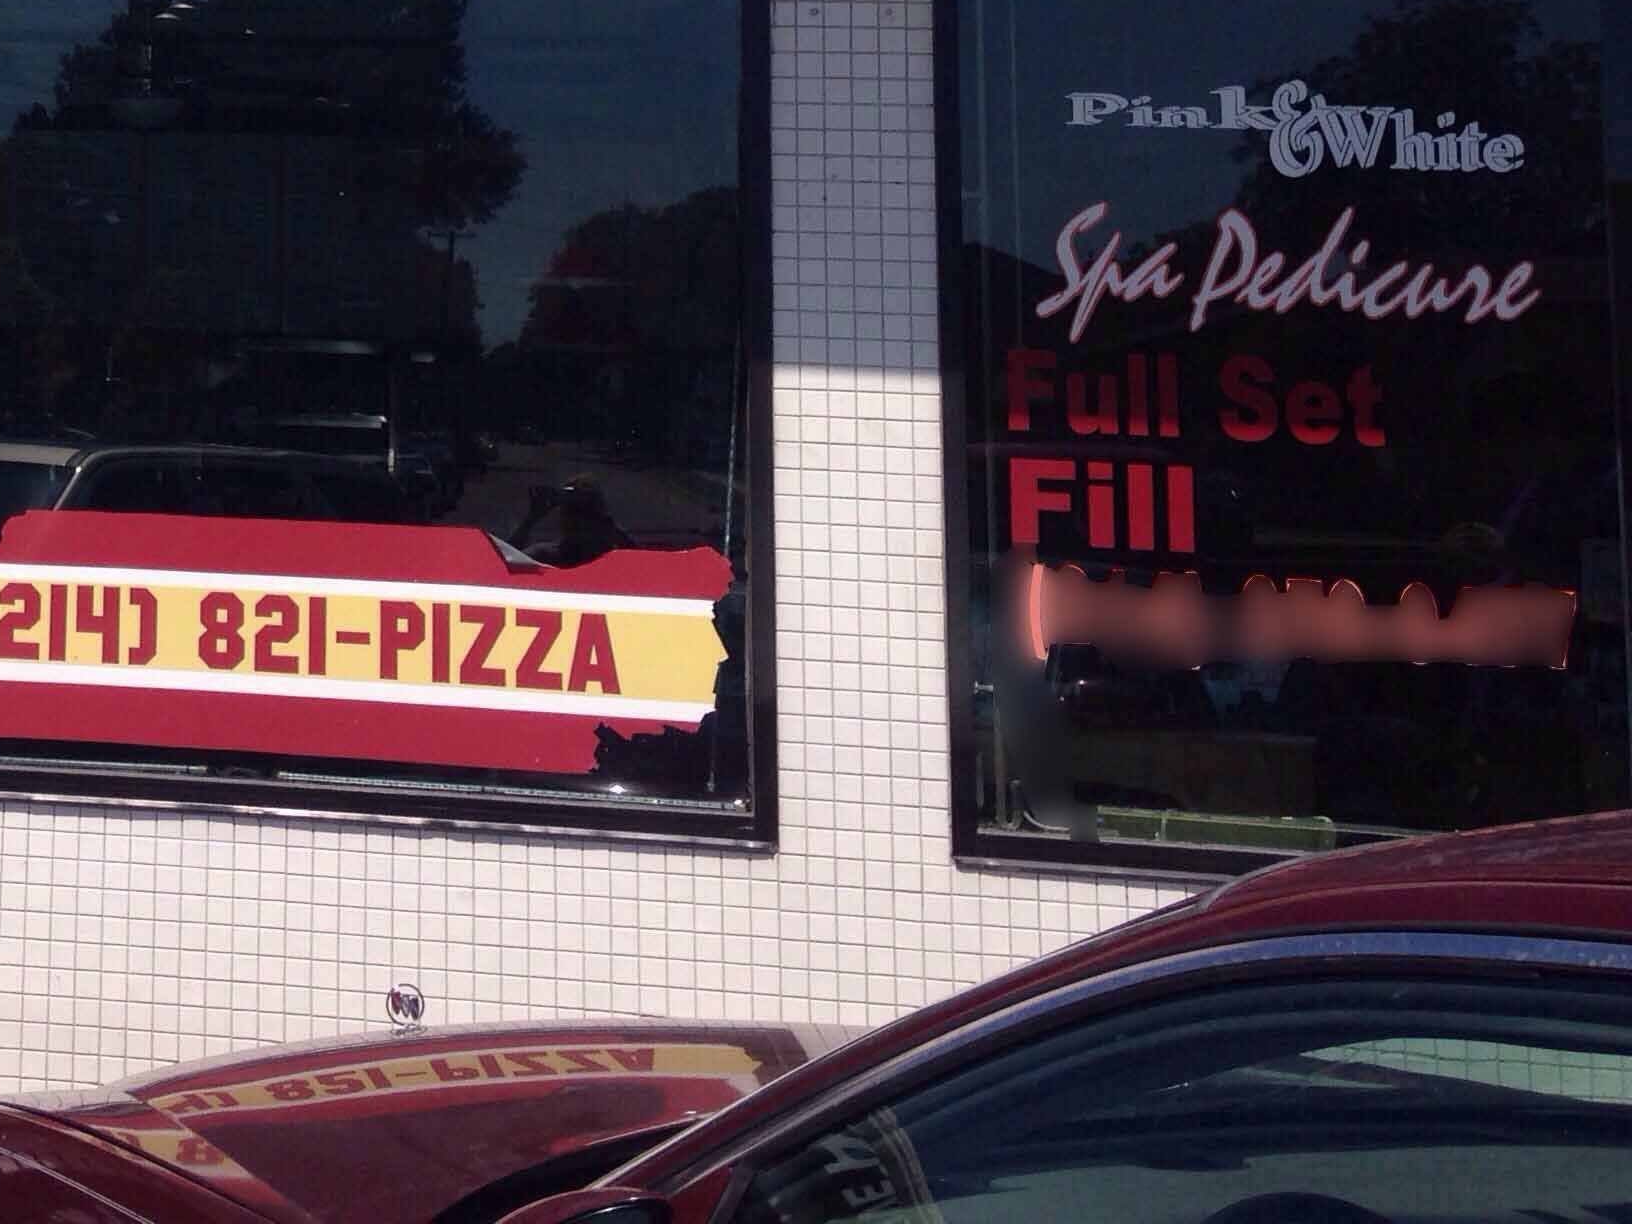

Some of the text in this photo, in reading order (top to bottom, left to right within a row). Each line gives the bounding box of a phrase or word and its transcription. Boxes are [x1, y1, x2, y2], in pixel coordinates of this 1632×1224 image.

[1036, 201, 1541, 344] Spa Pedicure
[1006, 347, 1387, 448] Full Set
[1009, 458, 1196, 554] Fill
[197, 591, 622, 696] 821-PIZZA
